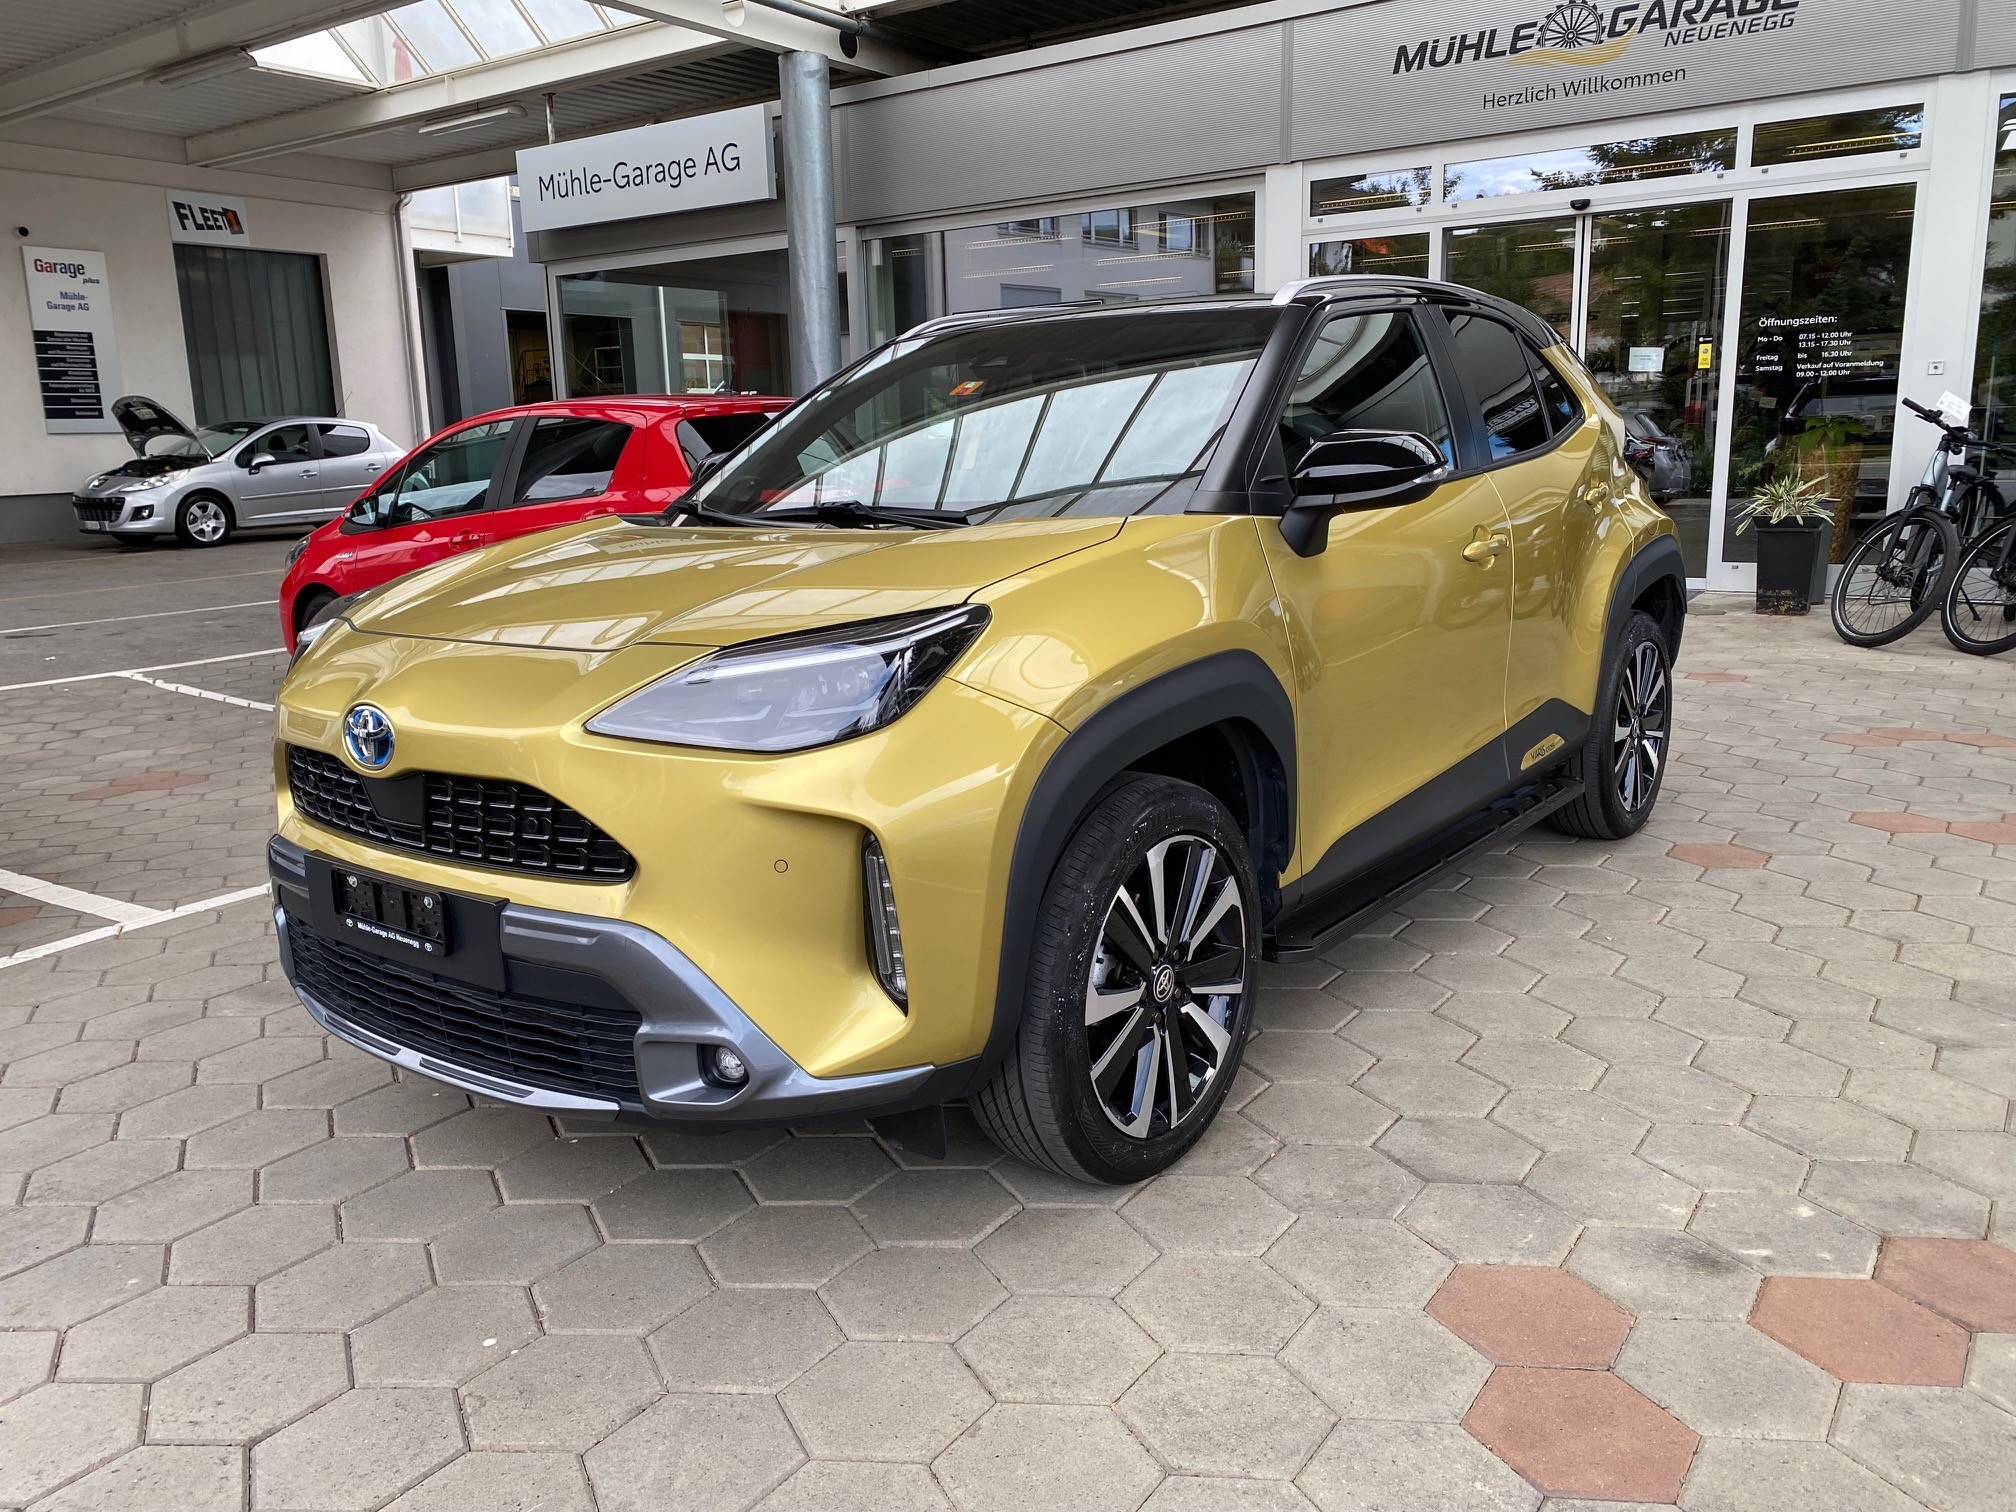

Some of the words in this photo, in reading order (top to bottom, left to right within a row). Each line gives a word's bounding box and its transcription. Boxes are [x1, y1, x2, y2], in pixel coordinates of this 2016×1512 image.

[1393, 21, 1538, 74] MÜHLE
[1606, 0, 1799, 38] GARA
[1664, 11, 1796, 47] NEUENEGG
[1483, 84, 1556, 110] Herzlich
[1562, 67, 1687, 98] Willkommen
[538, 157, 697, 202] Mühle-Garage
[704, 143, 741, 176] AG
[34, 258, 86, 279] Garage
[46, 301, 76, 312] Garage
[77, 302, 90, 311] AG
[1758, 315, 1838, 327] Öffnungszeiten:
[1821, 331, 1839, 339] 12.00
[1756, 354, 1779, 362] Freitag
[1821, 350, 1839, 358] 16.30
[1796, 362, 1822, 370] Verkauf
[1822, 361, 1834, 369] auf
[1834, 360, 1884, 368] Voranmeldung
